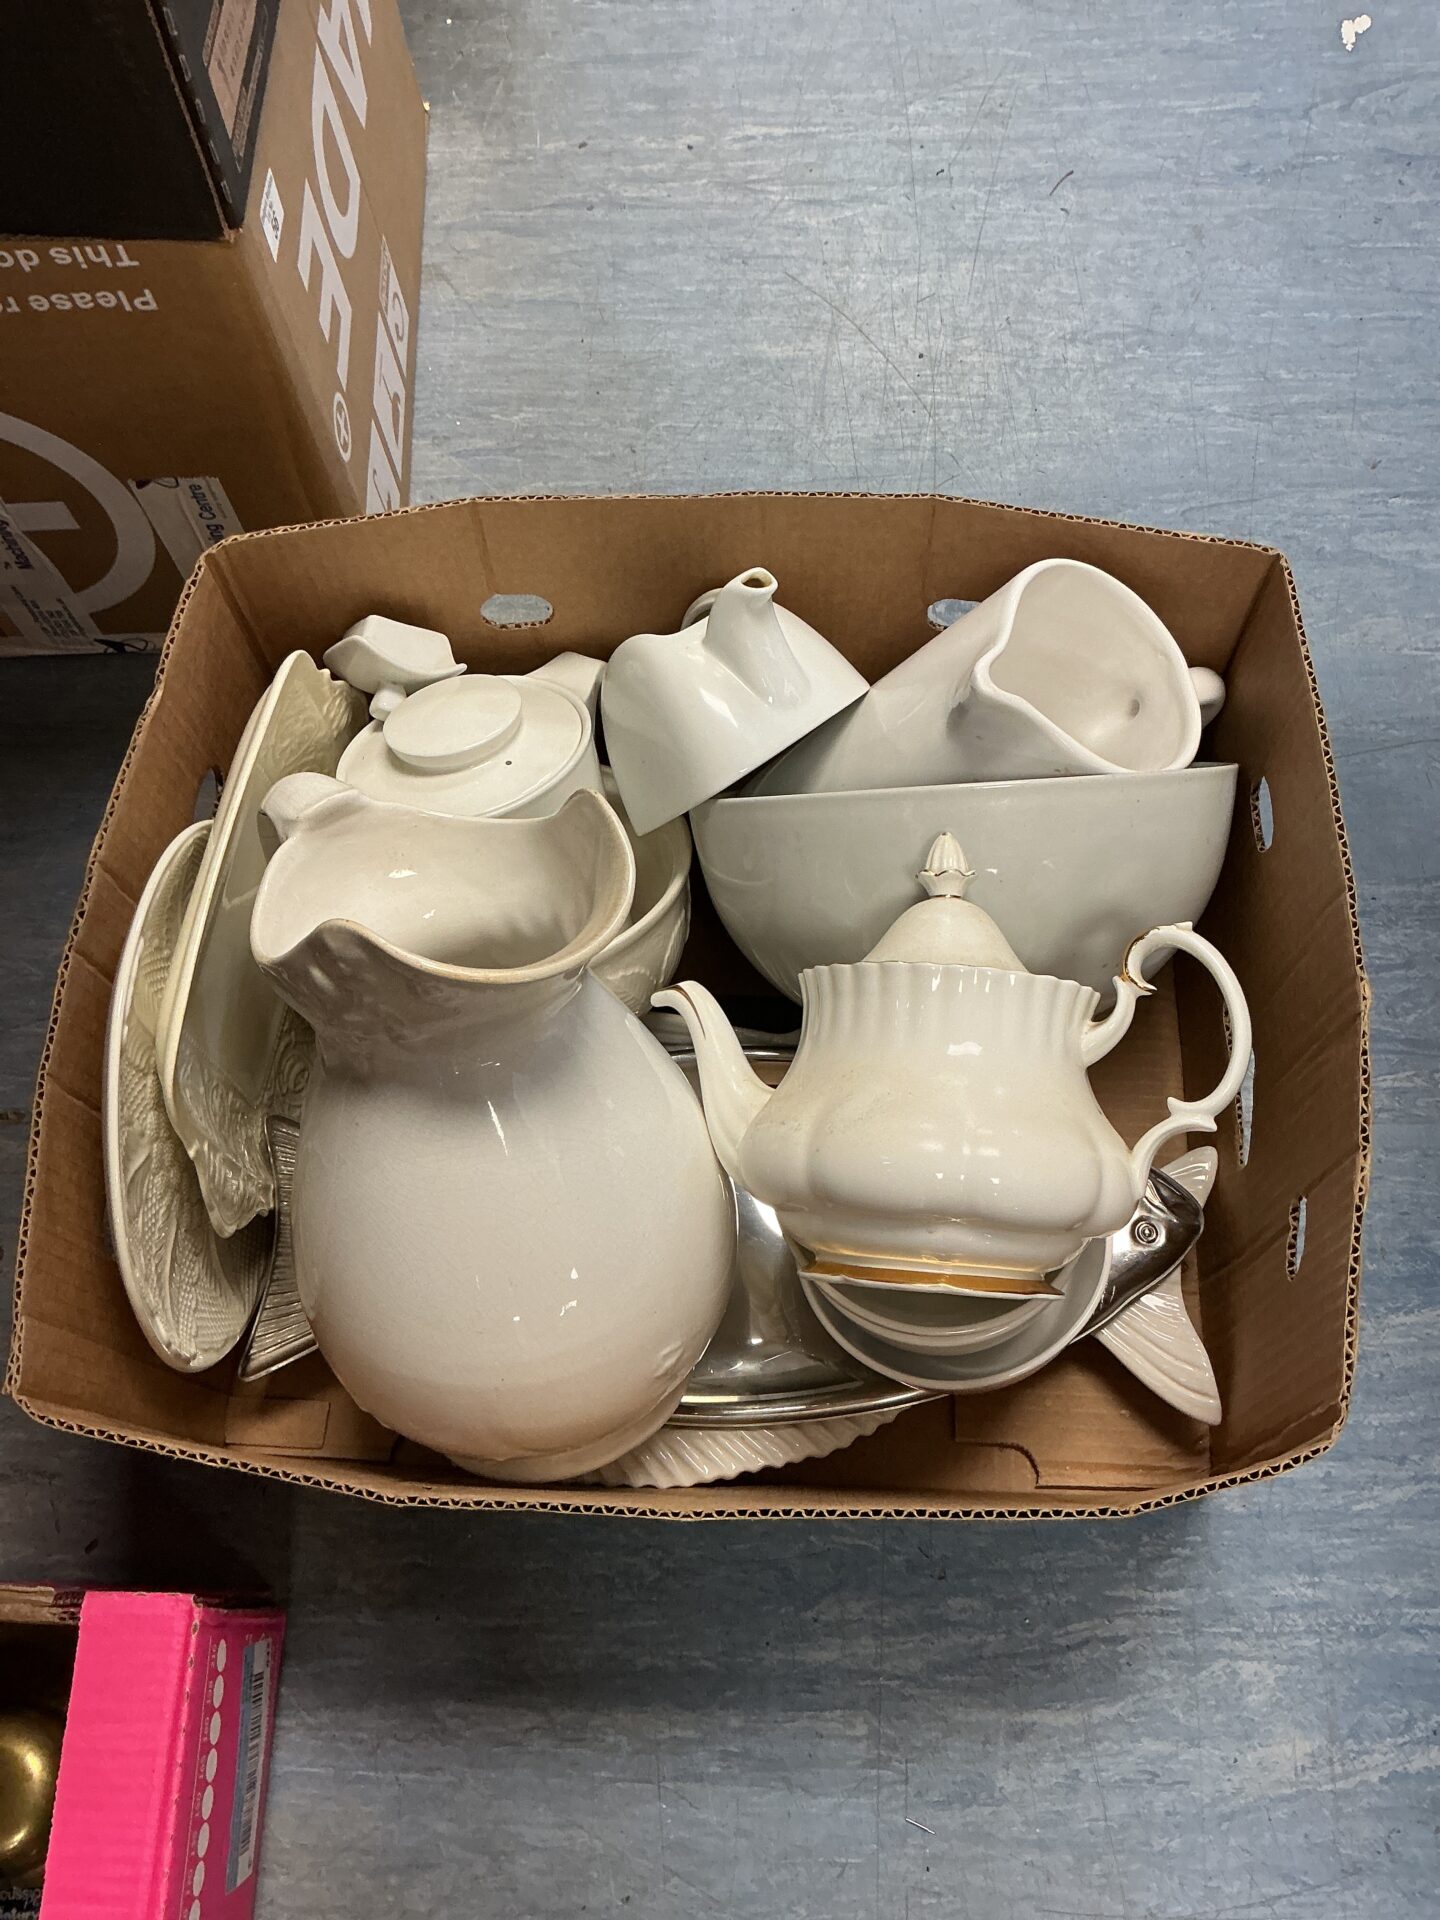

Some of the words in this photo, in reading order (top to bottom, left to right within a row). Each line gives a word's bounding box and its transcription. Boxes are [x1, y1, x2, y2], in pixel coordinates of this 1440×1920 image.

[297, 0, 373, 392] ADE
[48, 243, 141, 270] This
[0, 295, 21, 313] r
[27, 288, 160, 313] Please
[188, 483, 217, 521] Centre
